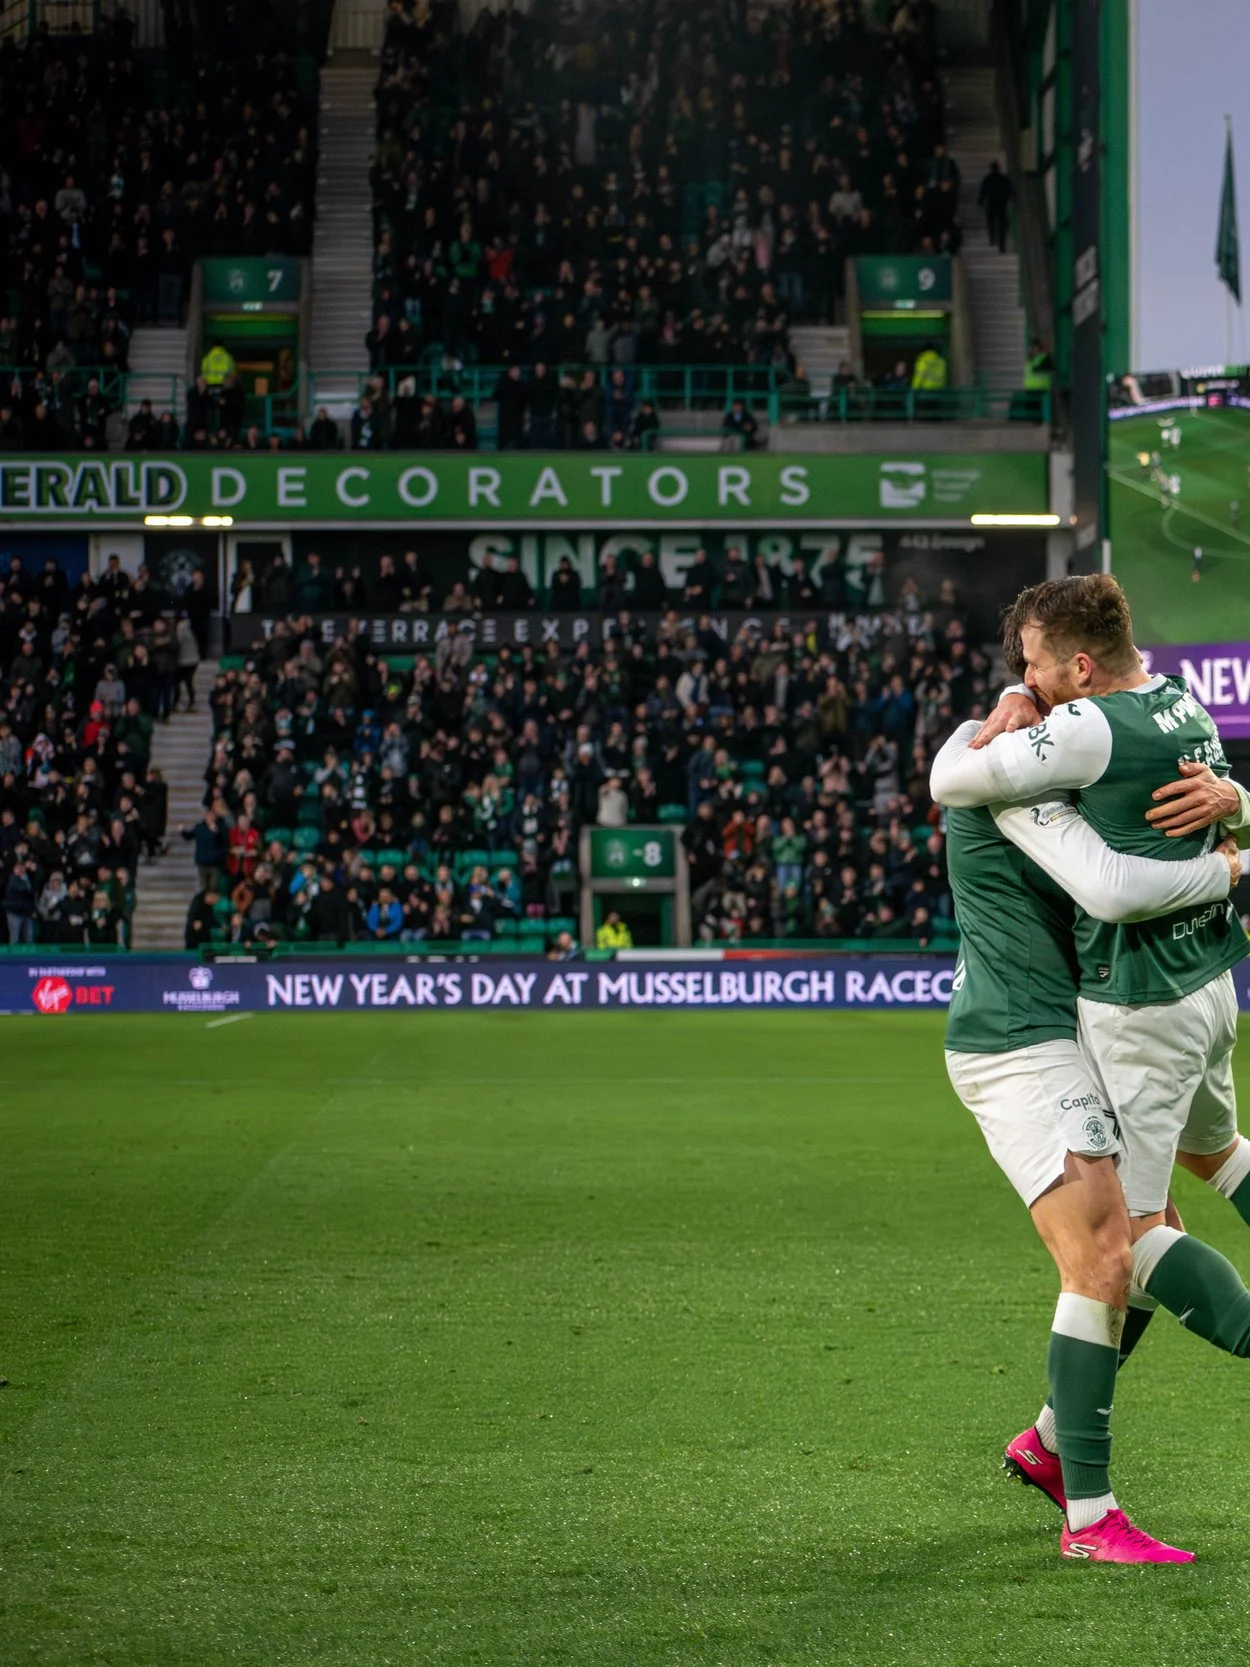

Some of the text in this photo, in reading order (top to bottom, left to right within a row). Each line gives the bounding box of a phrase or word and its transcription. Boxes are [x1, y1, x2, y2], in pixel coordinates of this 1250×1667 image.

[267, 269, 283, 292] 7
[918, 267, 935, 291] 9
[211, 466, 811, 507] DECORATORS
[643, 841, 662, 867] 8
[76, 985, 115, 1005] BET
[266, 974, 343, 1006] NEW
[350, 973, 462, 1006] YEAR'S
[471, 973, 537, 1005] DAY
[543, 973, 588, 1005] AT
[598, 971, 835, 1004] MUSSELBURGH
